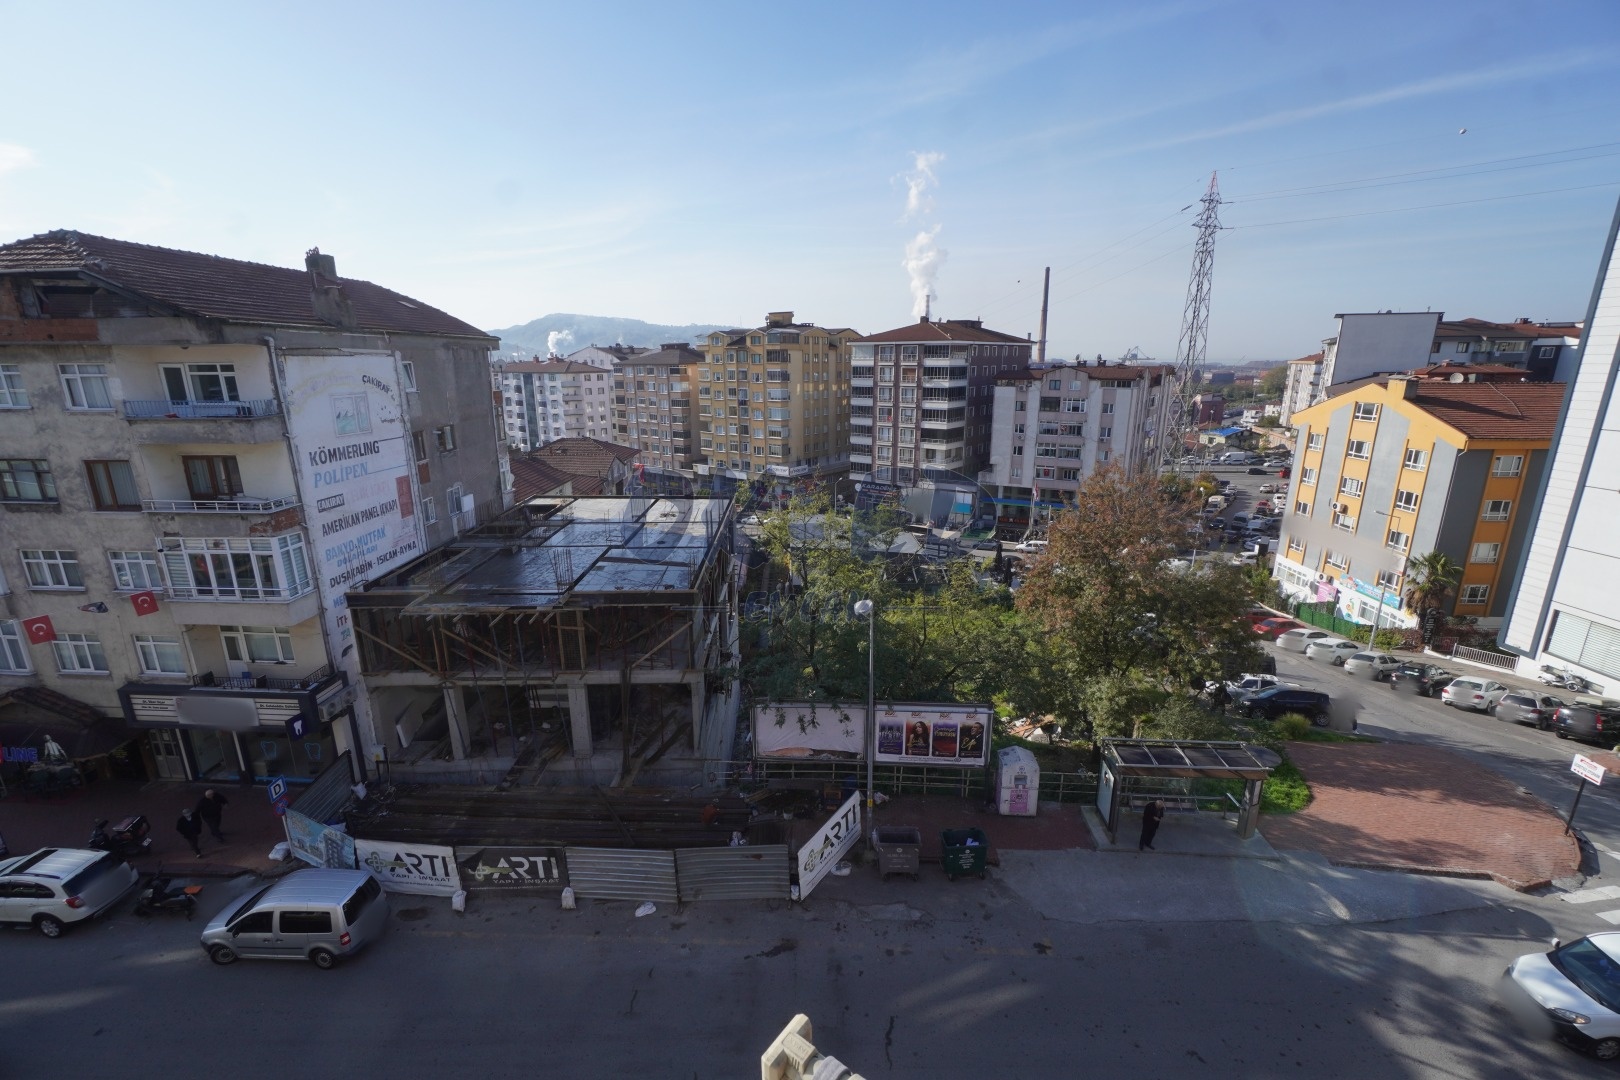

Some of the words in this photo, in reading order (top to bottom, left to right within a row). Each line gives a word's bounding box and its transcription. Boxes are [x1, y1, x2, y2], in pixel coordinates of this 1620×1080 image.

[308, 440, 380, 467] KÖMMERLING
[313, 462, 368, 488] POLİPEN
[321, 514, 361, 537] AMERİKAN
[361, 505, 380, 522] PANEL
[273, 784, 281, 796] D
[389, 853, 451, 878] ARTI
[493, 857, 560, 879] ARTI
